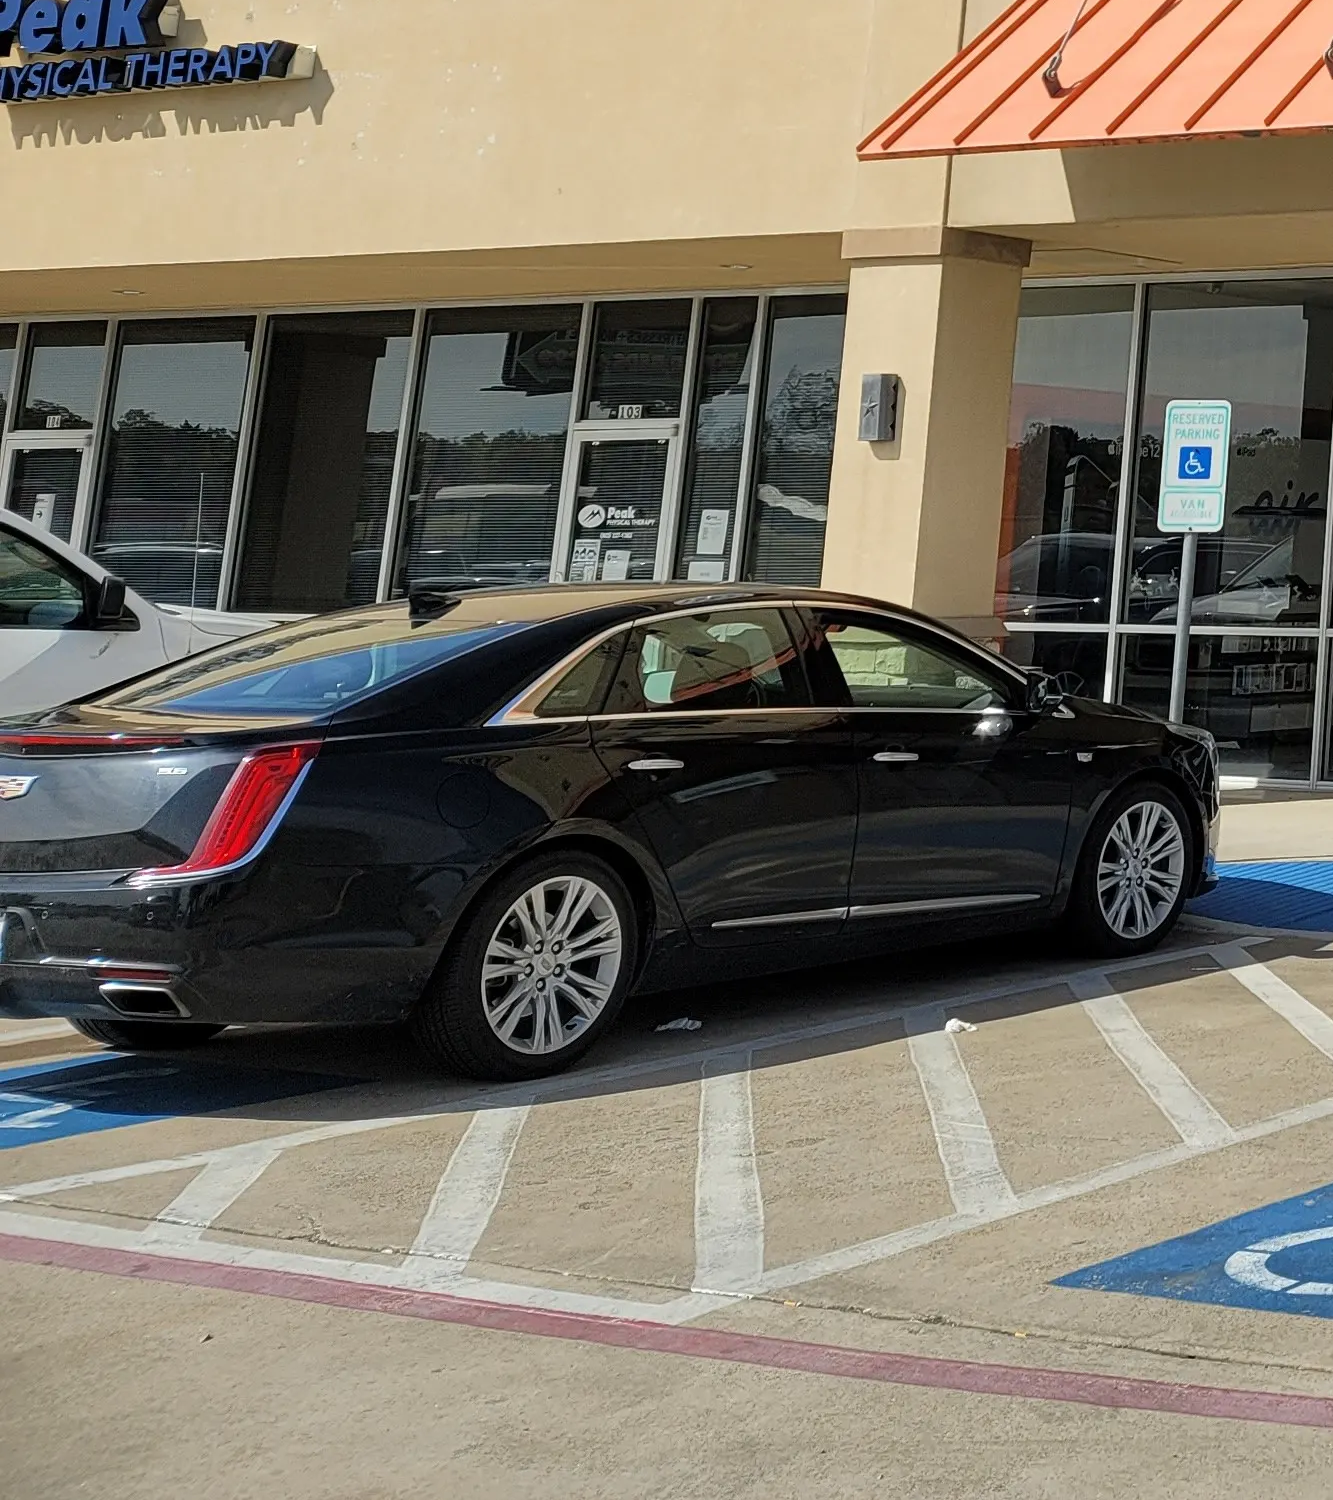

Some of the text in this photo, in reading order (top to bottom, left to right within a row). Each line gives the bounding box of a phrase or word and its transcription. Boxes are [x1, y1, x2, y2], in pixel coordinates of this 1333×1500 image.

[124, 40, 284, 89] THERAPY
[619, 406, 642, 419] 103
[1172, 413, 1225, 425] RESERVED
[1174, 428, 1220, 440] PARKING
[1180, 499, 1206, 509] VAN
[607, 505, 636, 519] Peak
